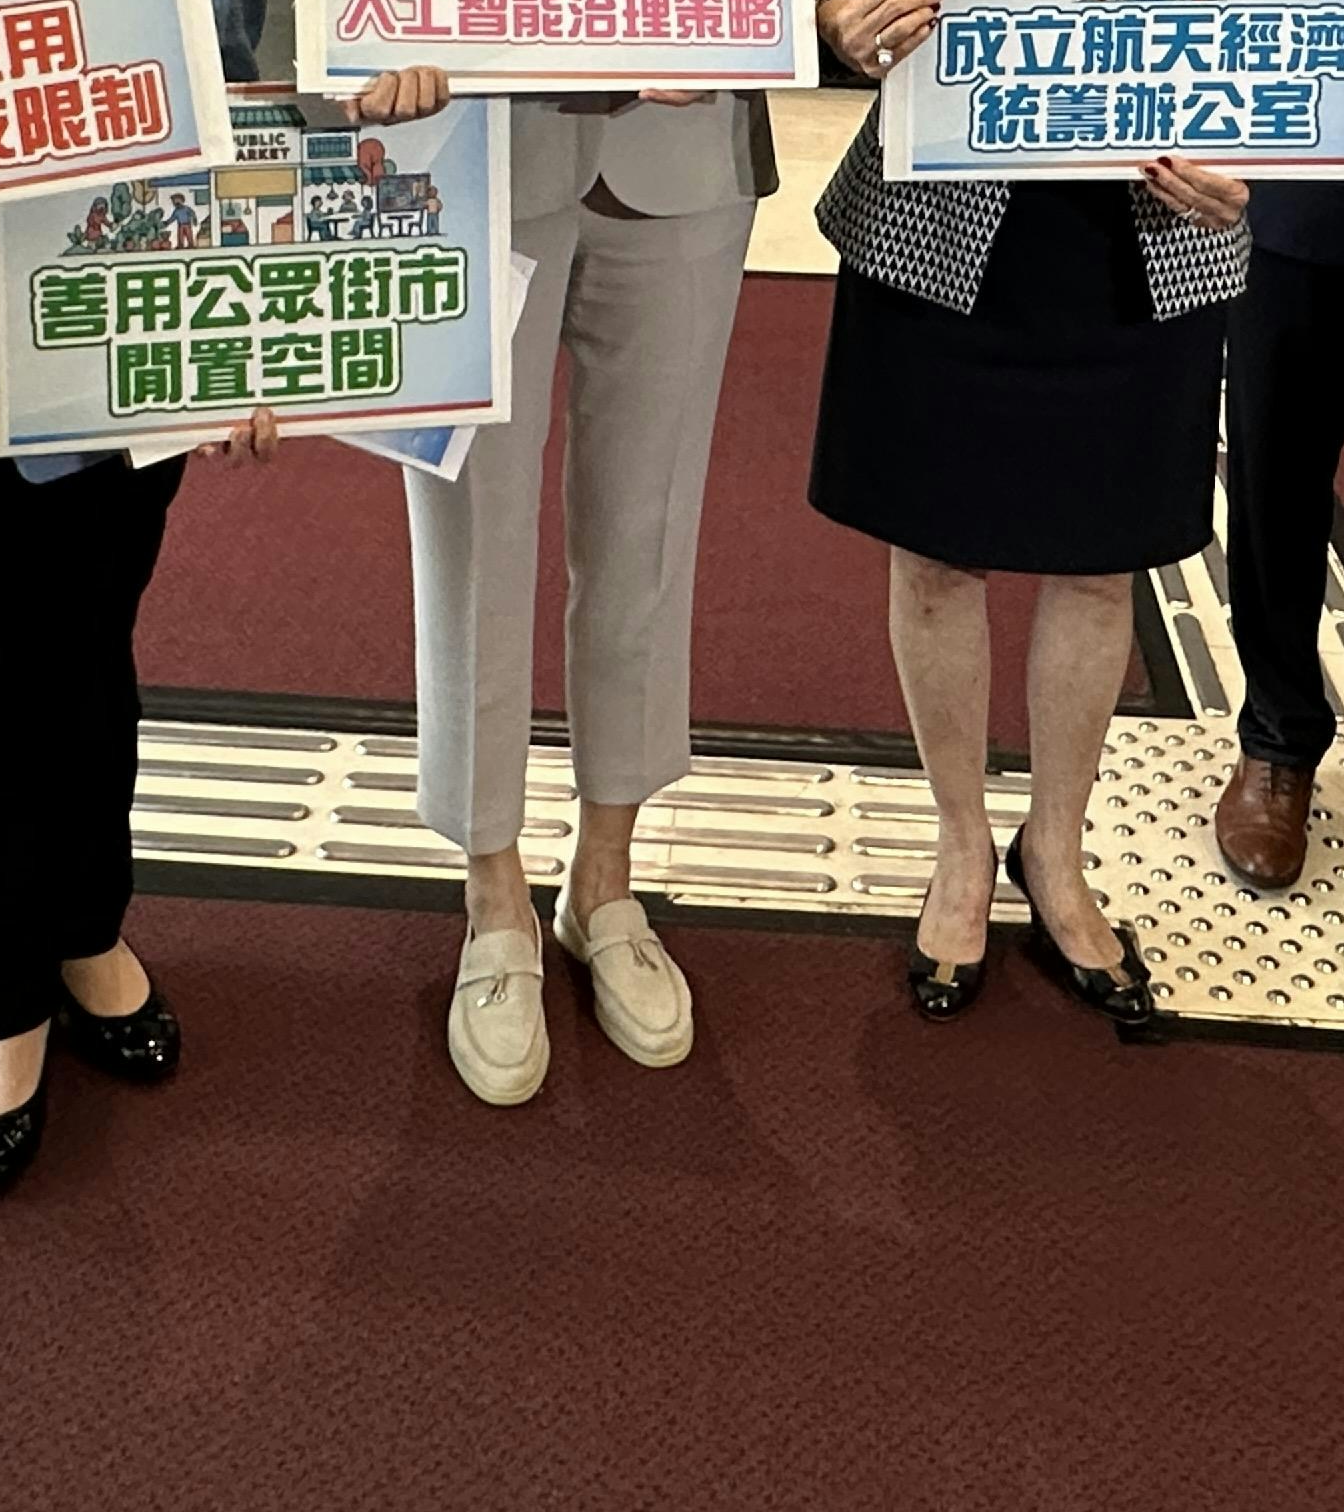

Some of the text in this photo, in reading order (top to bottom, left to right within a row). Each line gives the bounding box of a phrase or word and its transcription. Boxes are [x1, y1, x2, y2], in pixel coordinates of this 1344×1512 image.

[977, 81, 1314, 145] 統籌辦公室
[233, 132, 286, 147] UBLIC
[236, 147, 290, 161] ARKET
[36, 253, 460, 341] 善用公眾街市
